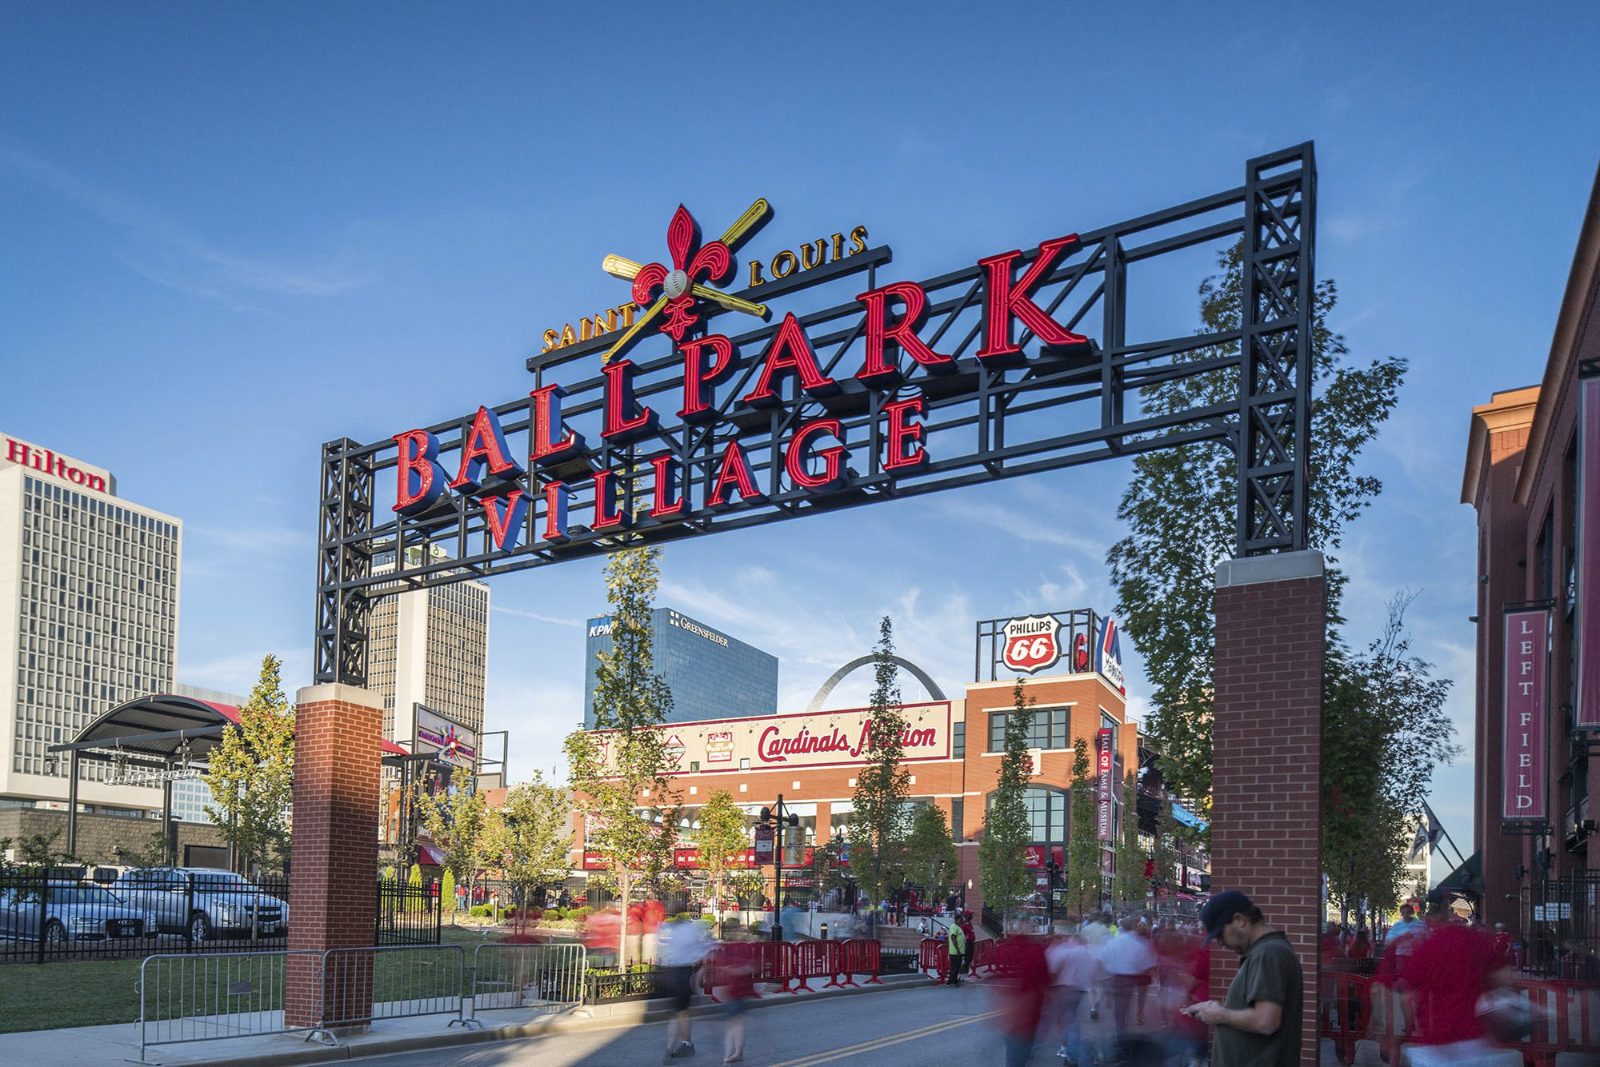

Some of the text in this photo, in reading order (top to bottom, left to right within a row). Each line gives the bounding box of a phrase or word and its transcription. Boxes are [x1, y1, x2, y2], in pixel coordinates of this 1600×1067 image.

[542, 225, 869, 353] SAINT LOUIS
[392, 233, 1088, 512] BALLPARK
[5, 438, 107, 494] Hilton
[480, 396, 928, 551] VILLAGE
[589, 623, 615, 638] KPM
[680, 617, 729, 648] GREENSFELDER
[1009, 620, 1052, 635] PHILLIPS
[1010, 637, 1051, 662] 66
[1516, 620, 1534, 810] LEFT FIELD
[758, 719, 937, 763] Cardinals Nion
[1101, 733, 1110, 755] HALL
[1100, 755, 1109, 768] OF
[1100, 768, 1109, 790] FAME
[1099, 800, 1108, 836] MUSEUM
